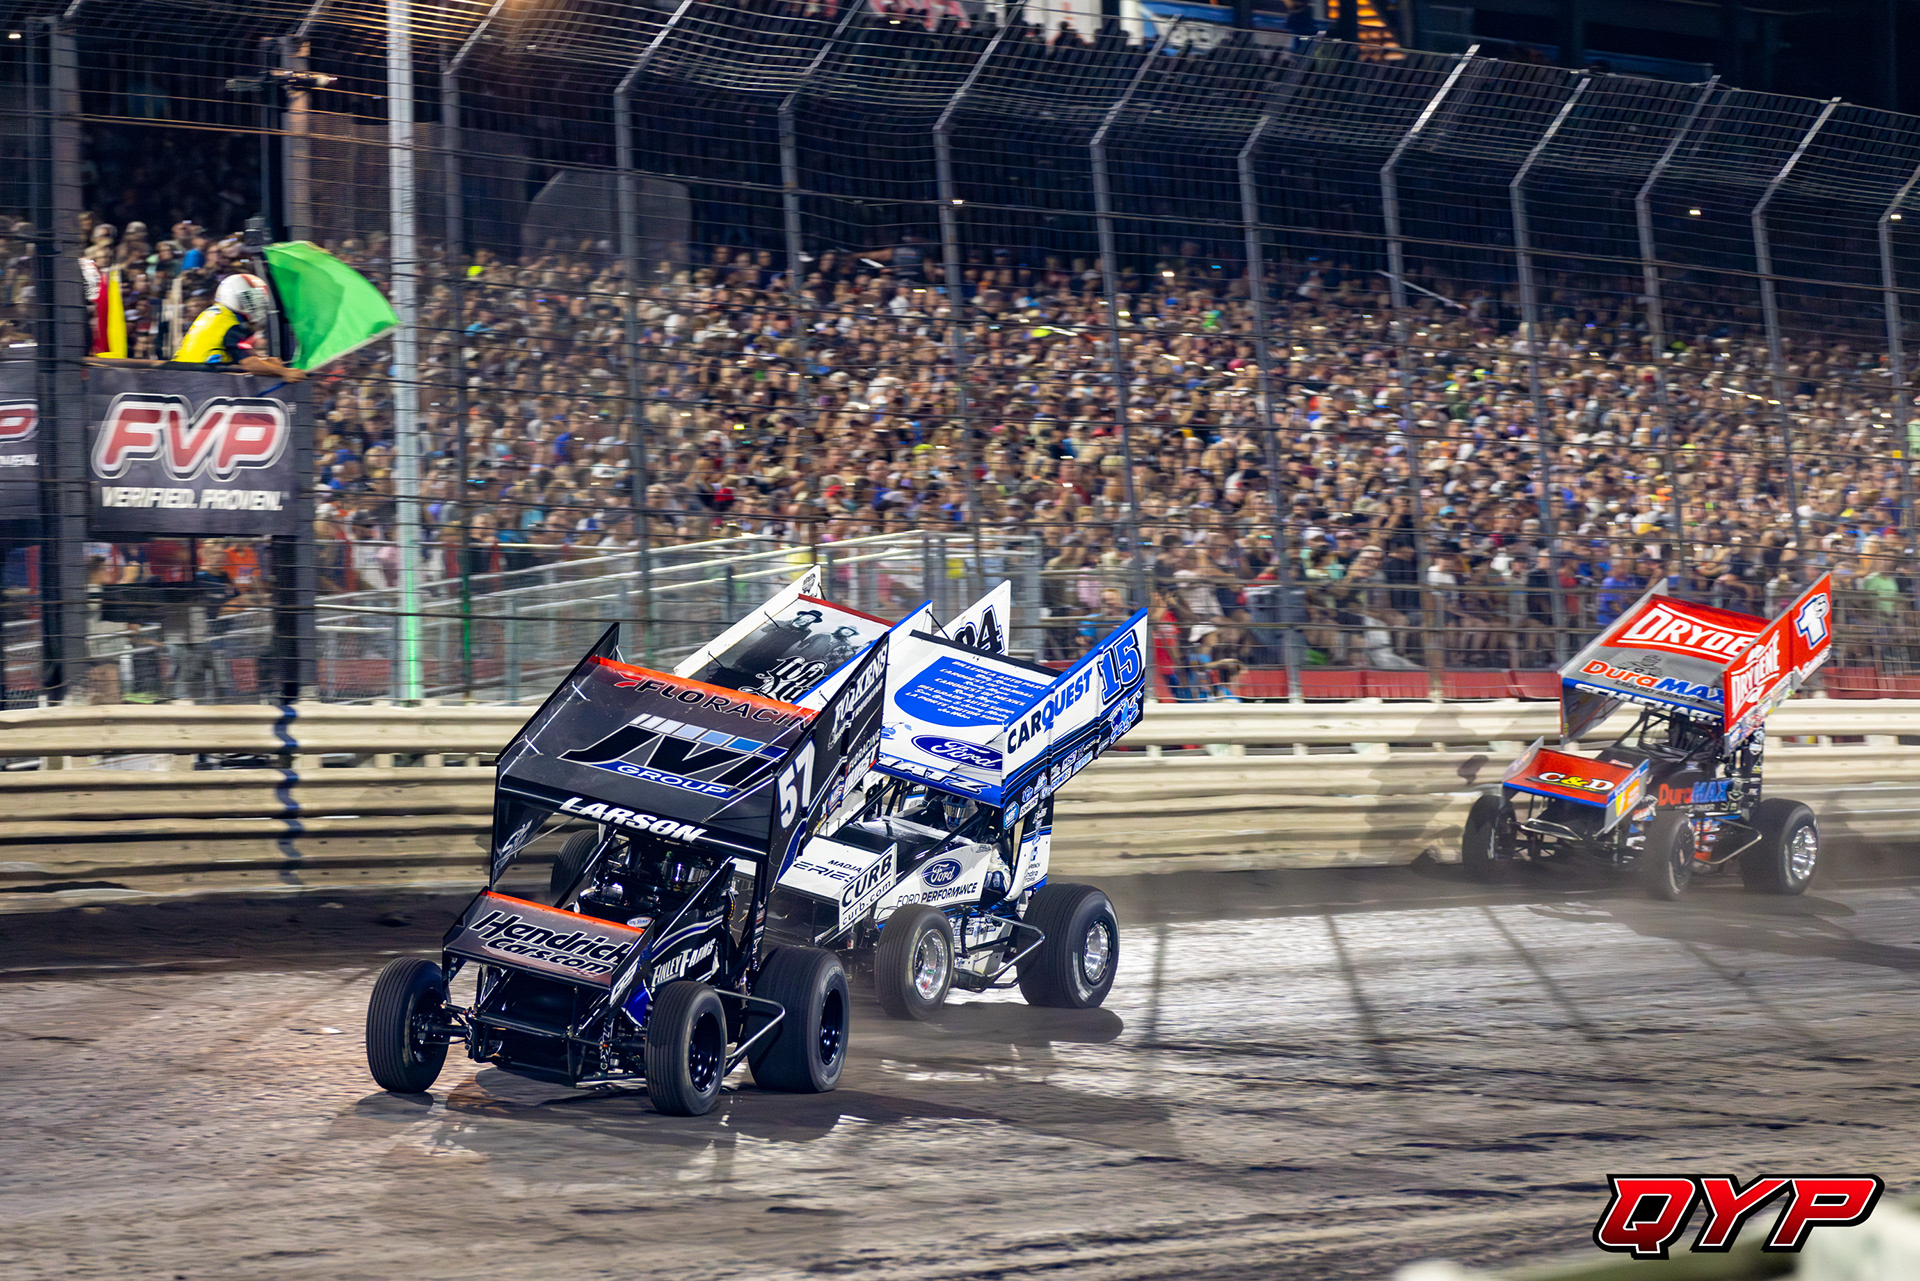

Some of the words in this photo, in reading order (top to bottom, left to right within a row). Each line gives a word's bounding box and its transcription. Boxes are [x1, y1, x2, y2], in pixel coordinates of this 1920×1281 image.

[97, 396, 288, 478] FVP
[1097, 629, 1143, 705] 15
[1007, 666, 1093, 754] CARQUEST
[931, 741, 1002, 767] Ford
[617, 764, 729, 795] GROUP
[778, 739, 815, 829] 57
[1538, 771, 1616, 791] C&D
[1658, 780, 1733, 806] DuraMAX
[559, 797, 708, 843] LARSON
[842, 853, 893, 907] CURB
[897, 893, 920, 907] FORD
[921, 882, 978, 904] PERFORMANCE
[931, 863, 956, 883] Ford
[842, 881, 892, 926] curb.com
[469, 910, 633, 966] Hendrick
[651, 955, 683, 992] FINLEY
[679, 937, 717, 978] FARMS
